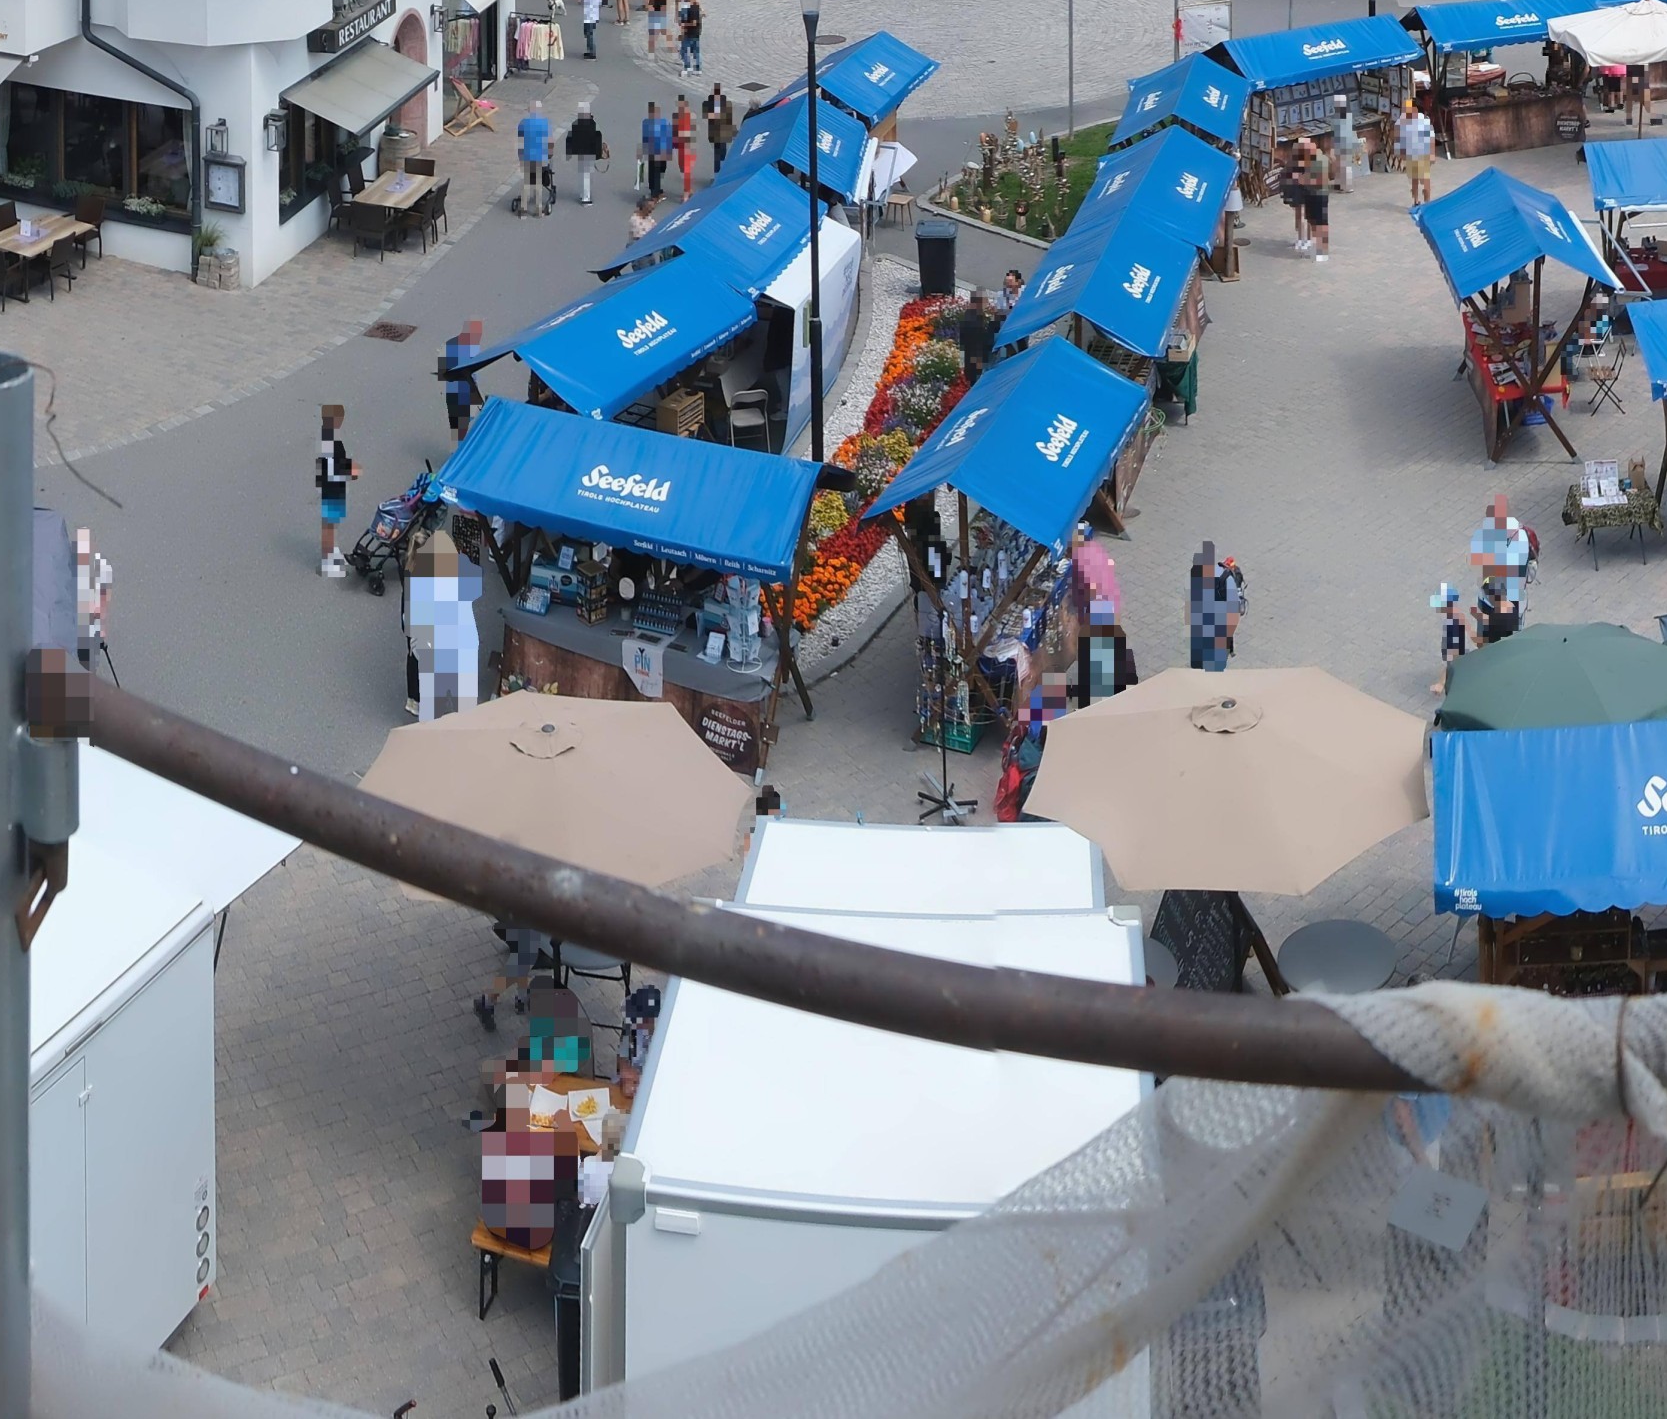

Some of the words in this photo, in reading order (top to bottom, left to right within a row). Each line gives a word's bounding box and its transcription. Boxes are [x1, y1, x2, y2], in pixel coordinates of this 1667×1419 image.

[616, 310, 669, 349] Seefeld
[1035, 413, 1078, 462] Seefeld
[581, 464, 671, 502] Seefeld
[577, 489, 603, 502] TIROLS
[605, 495, 660, 513] HOCHPLATEAU
[633, 539, 653, 551] Seefeld
[660, 544, 687, 558] Leutasch
[694, 552, 717, 564] Mösern
[723, 558, 741, 569] Reith
[747, 563, 777, 576] Scharnitz
[702, 716, 752, 742] DIENSTAGS-
[711, 709, 746, 727] SEEFELDER
[705, 730, 745, 752] MARKT'L
[1454, 888, 1478, 897] #tirols
[1455, 902, 1482, 911] plateau
